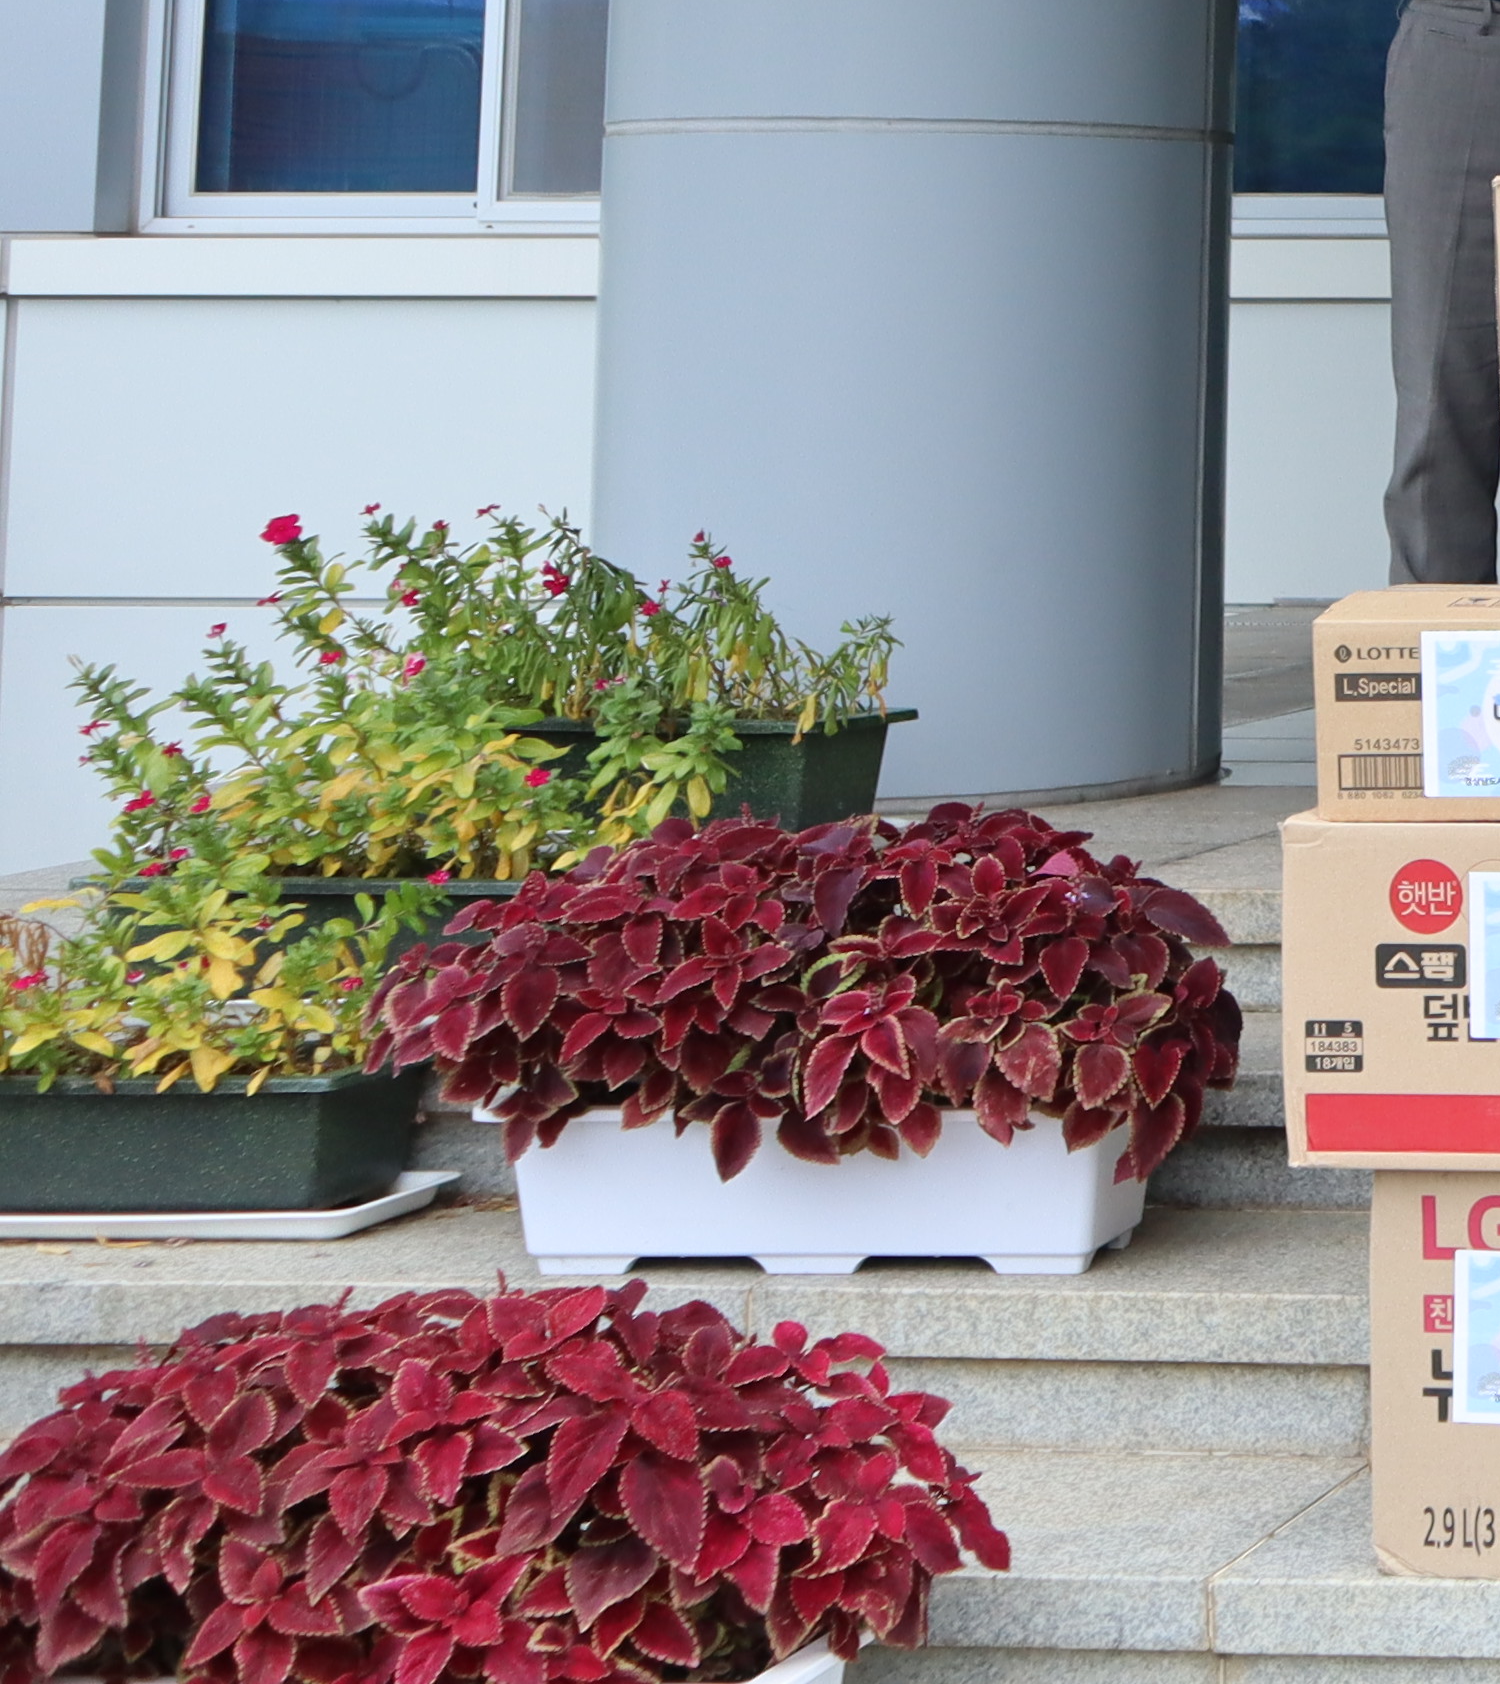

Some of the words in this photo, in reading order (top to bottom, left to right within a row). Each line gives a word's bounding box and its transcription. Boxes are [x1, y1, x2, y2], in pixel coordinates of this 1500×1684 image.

[1357, 647, 1419, 660] LOTTE
[1343, 677, 1416, 697] L.Special
[1354, 738, 1420, 750] 5143473
[1397, 880, 1457, 916] 햇반
[1383, 951, 1457, 981] 스팸
[1310, 1041, 1358, 1053] 184383
[1315, 1057, 1355, 1070] 18개입
[1423, 1506, 1455, 1549] 2.9
